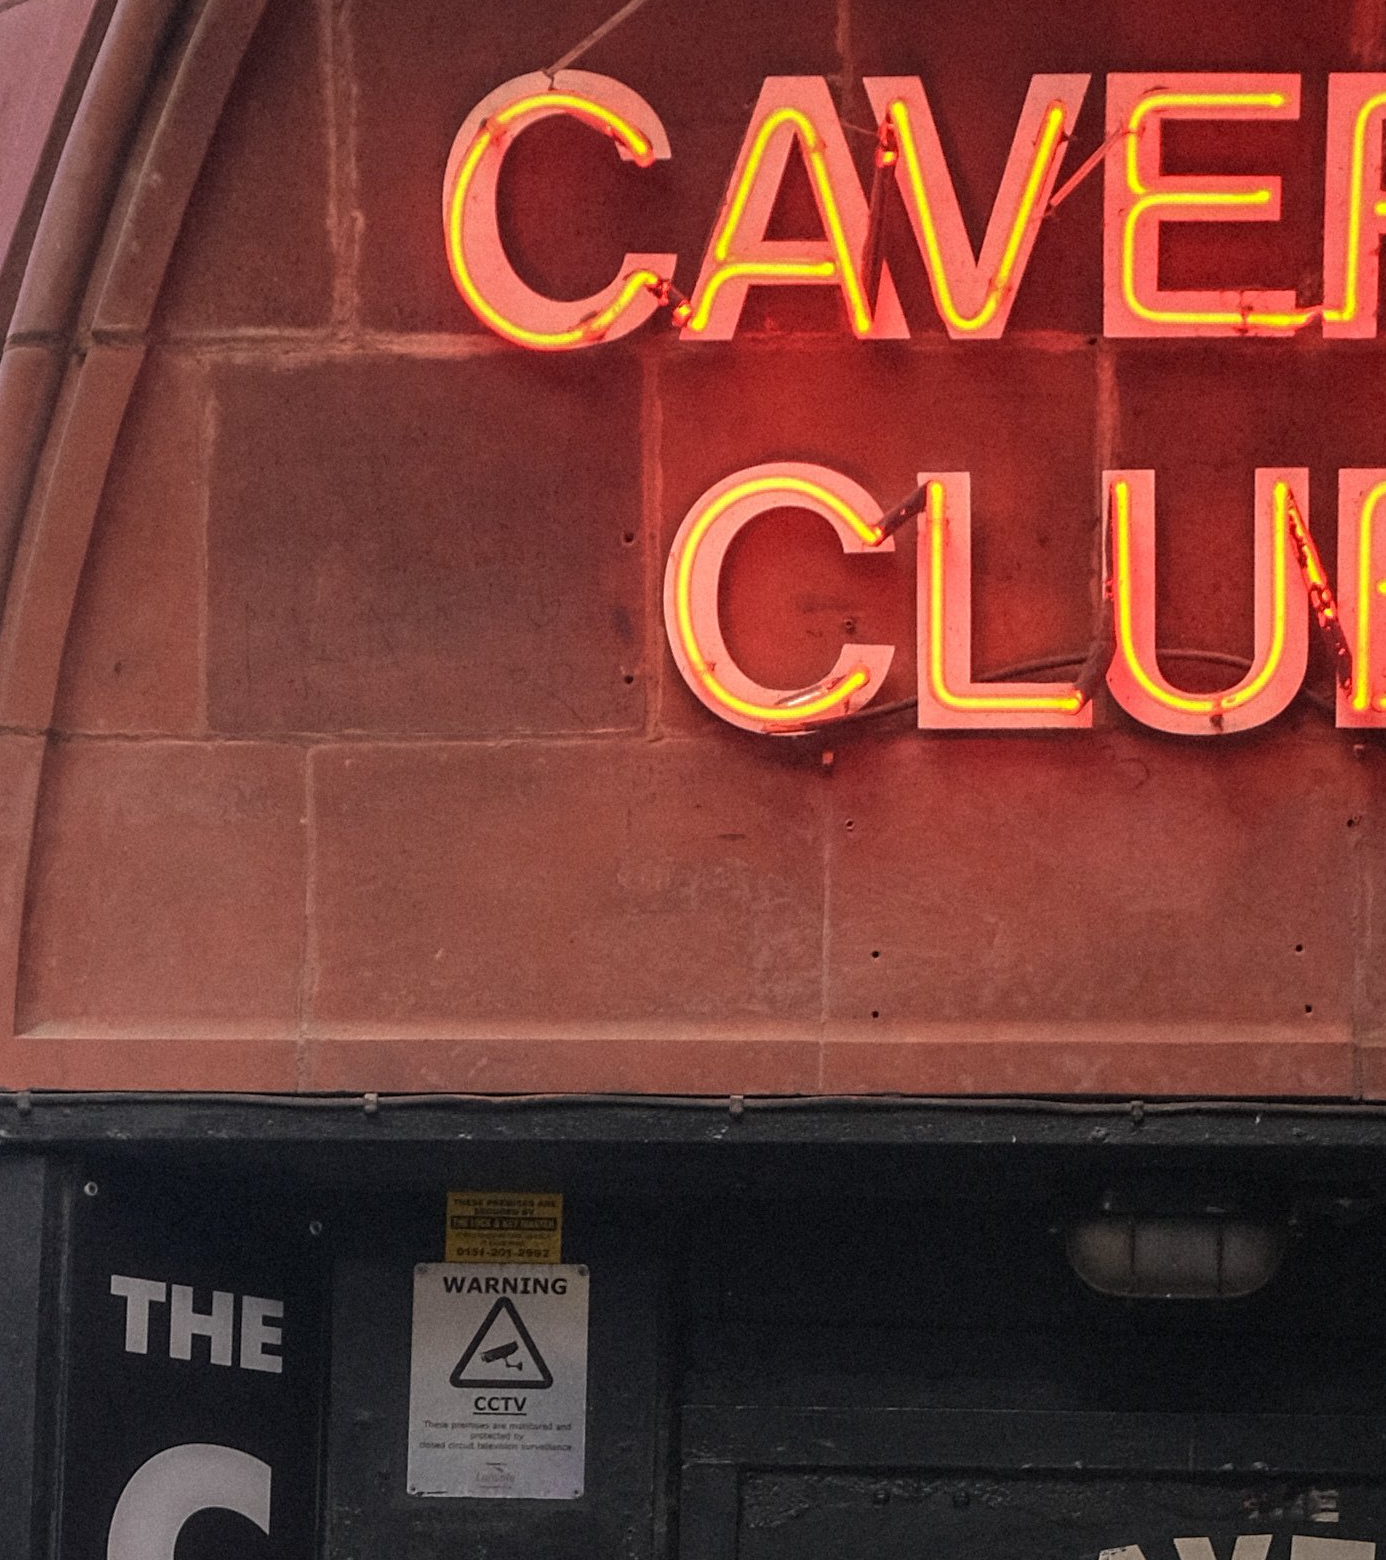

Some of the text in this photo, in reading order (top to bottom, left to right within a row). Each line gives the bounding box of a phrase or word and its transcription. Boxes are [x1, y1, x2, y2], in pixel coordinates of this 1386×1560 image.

[443, 1276, 568, 1296] WARNING
[110, 1274, 284, 1374] THE
[474, 1396, 527, 1412] CCTV
